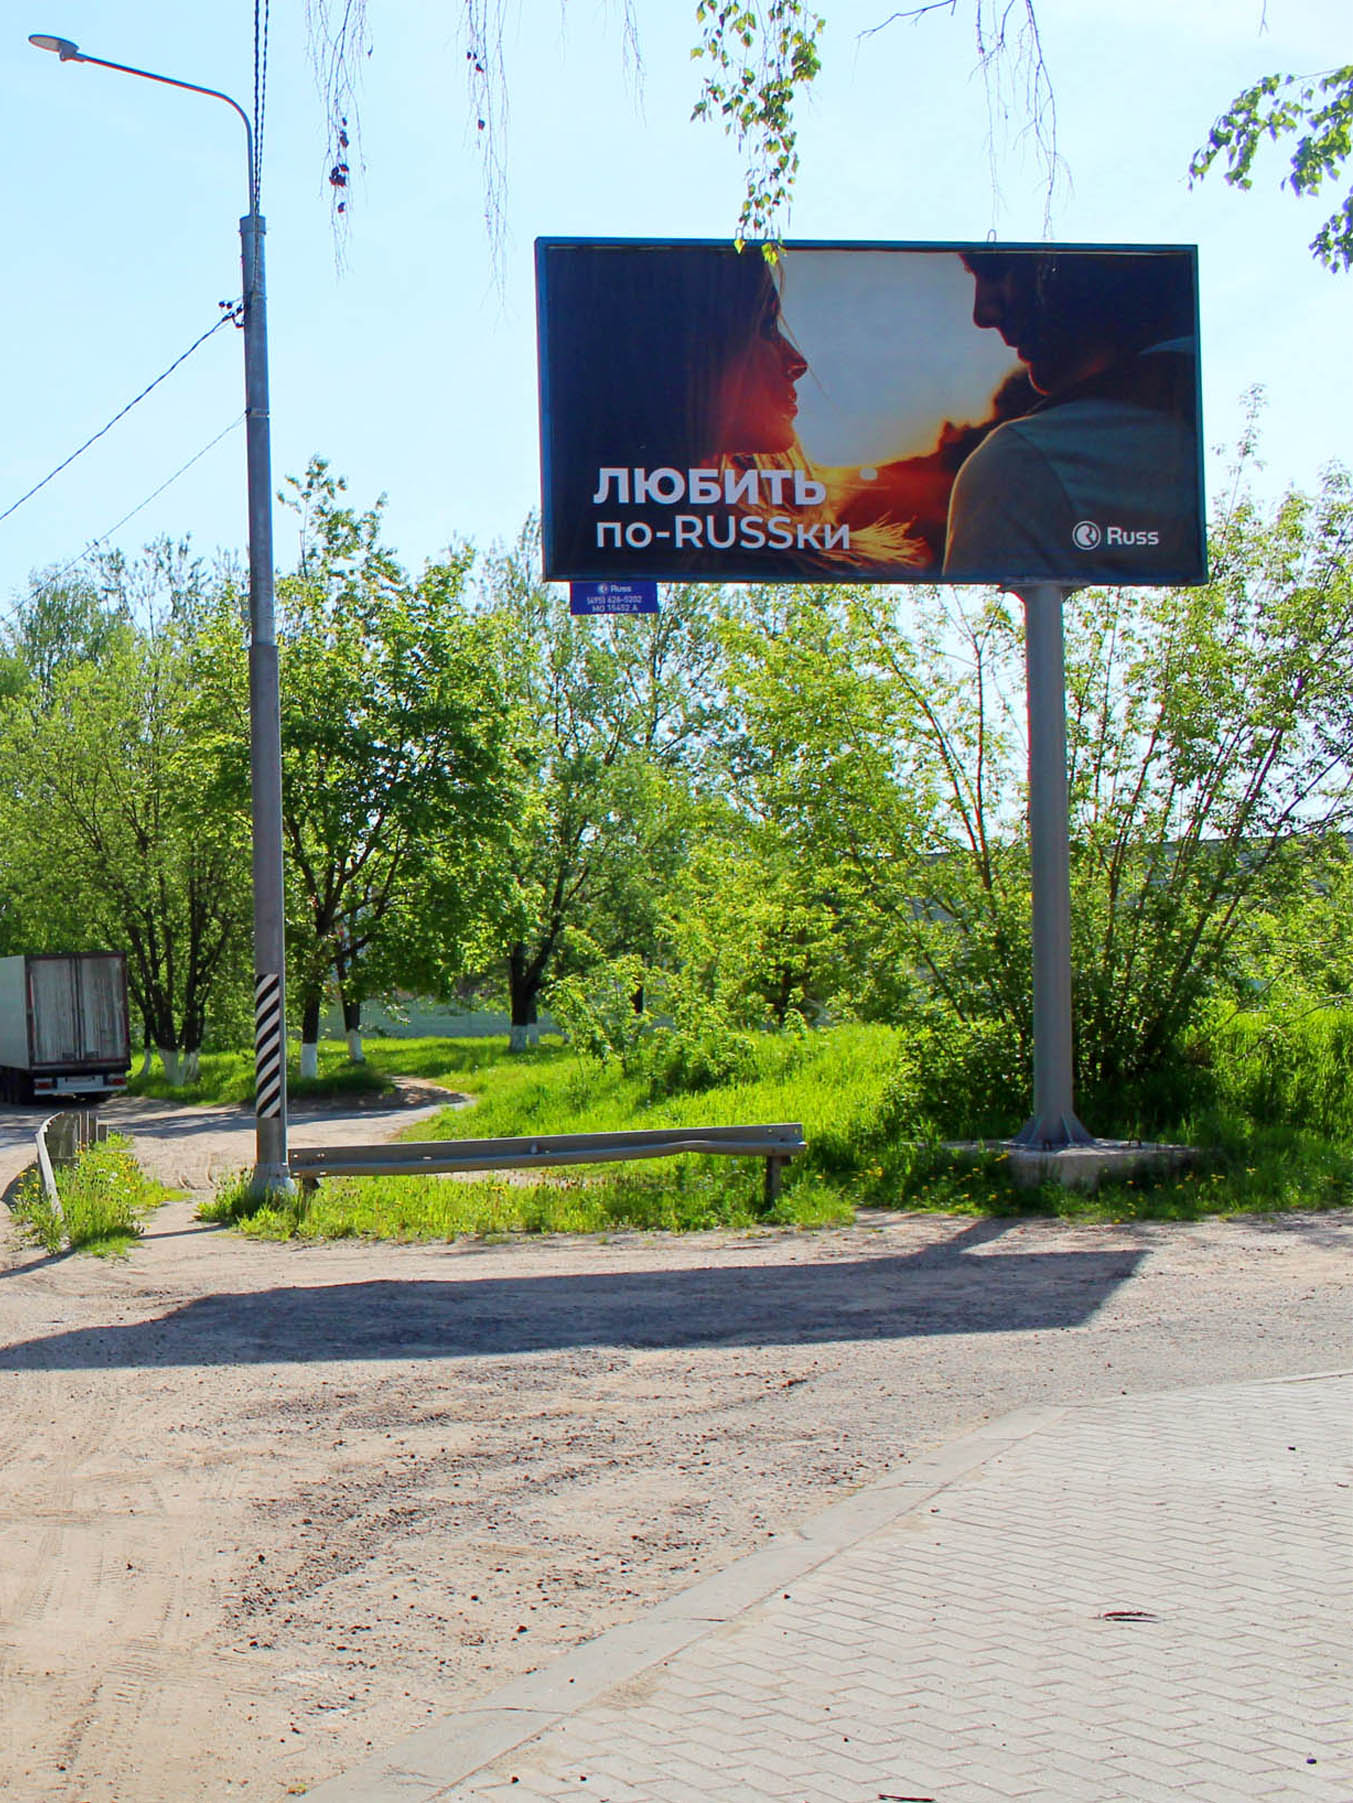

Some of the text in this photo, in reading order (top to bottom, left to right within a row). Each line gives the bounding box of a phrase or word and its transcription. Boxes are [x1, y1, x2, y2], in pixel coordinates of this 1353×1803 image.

[593, 467, 827, 505] ЛЮБИТЬ
[596, 515, 850, 550] по-RUSSки
[1107, 526, 1159, 545] Russ
[610, 584, 632, 593] Russ
